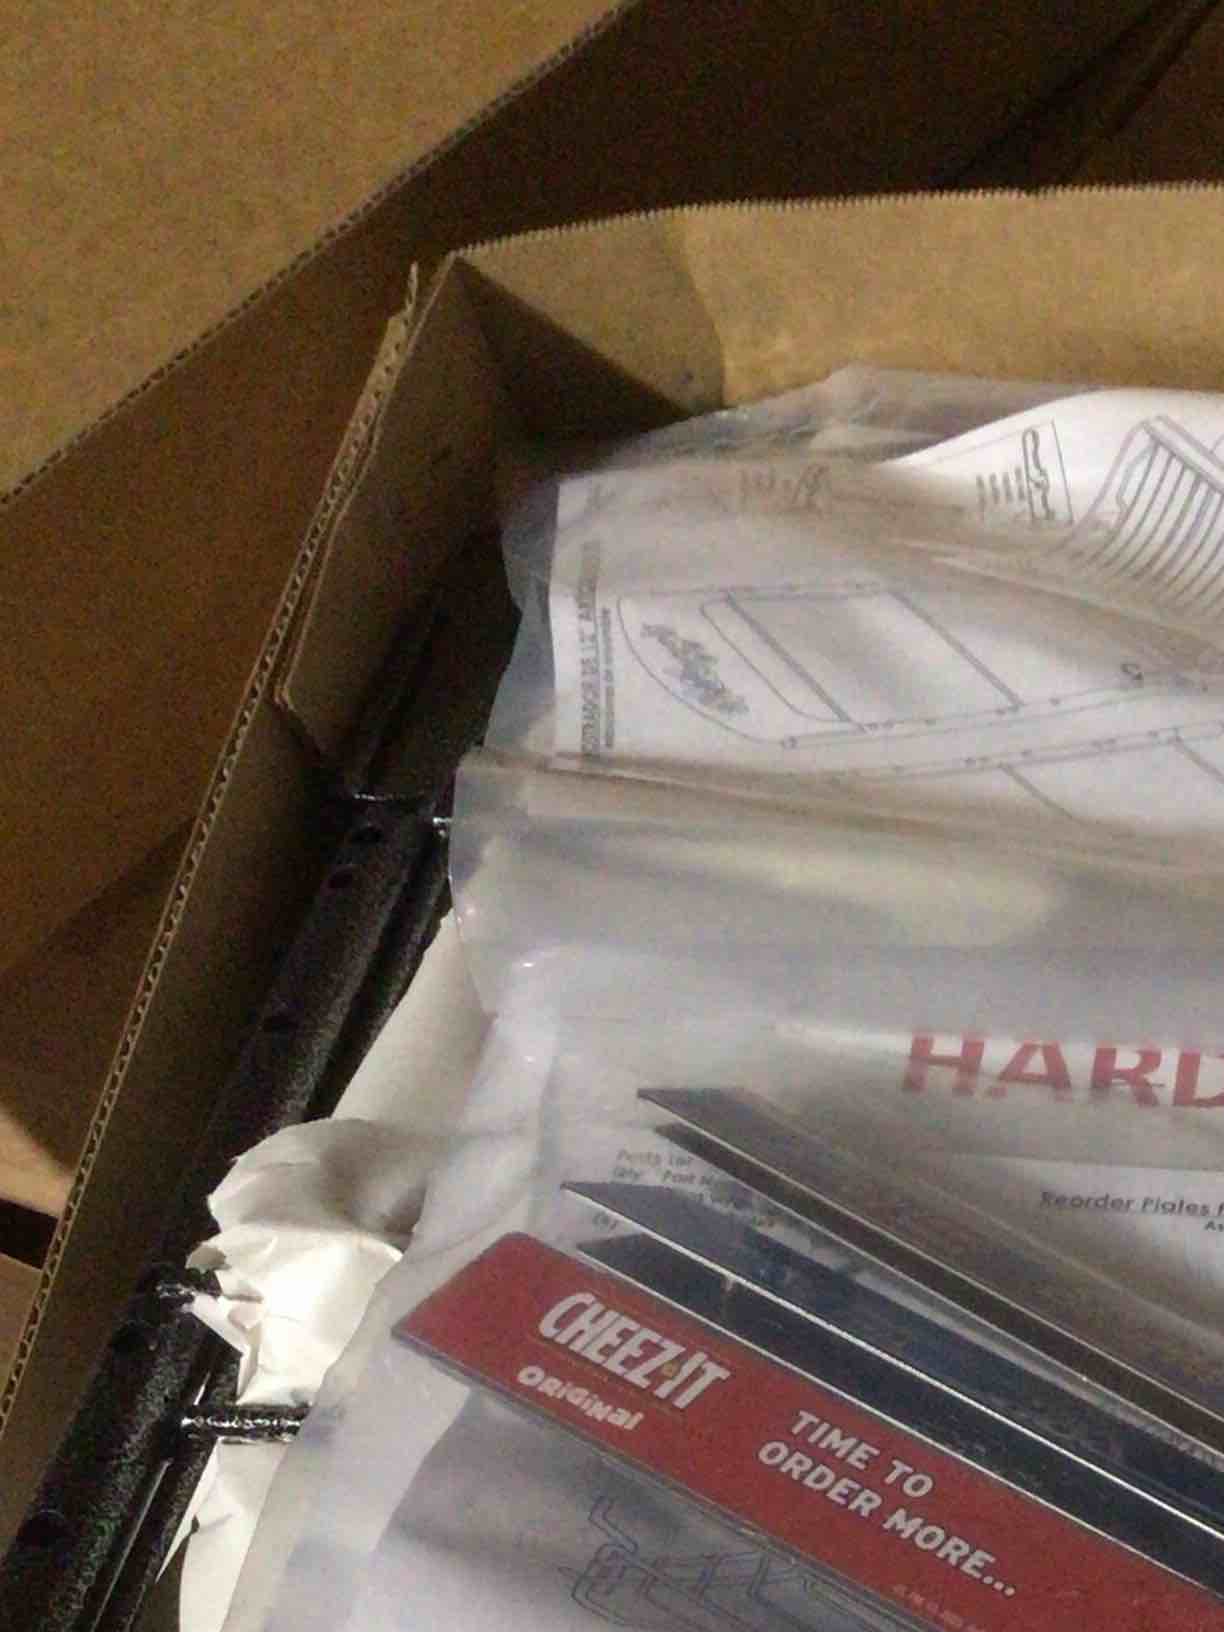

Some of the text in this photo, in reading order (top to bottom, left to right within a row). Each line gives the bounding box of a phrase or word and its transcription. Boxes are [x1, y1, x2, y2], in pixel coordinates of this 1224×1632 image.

[1040, 1191, 1134, 1213] Reorder
[791, 1410, 934, 1497] TIME TO
[758, 1441, 1016, 1597] ORDER MORE...
